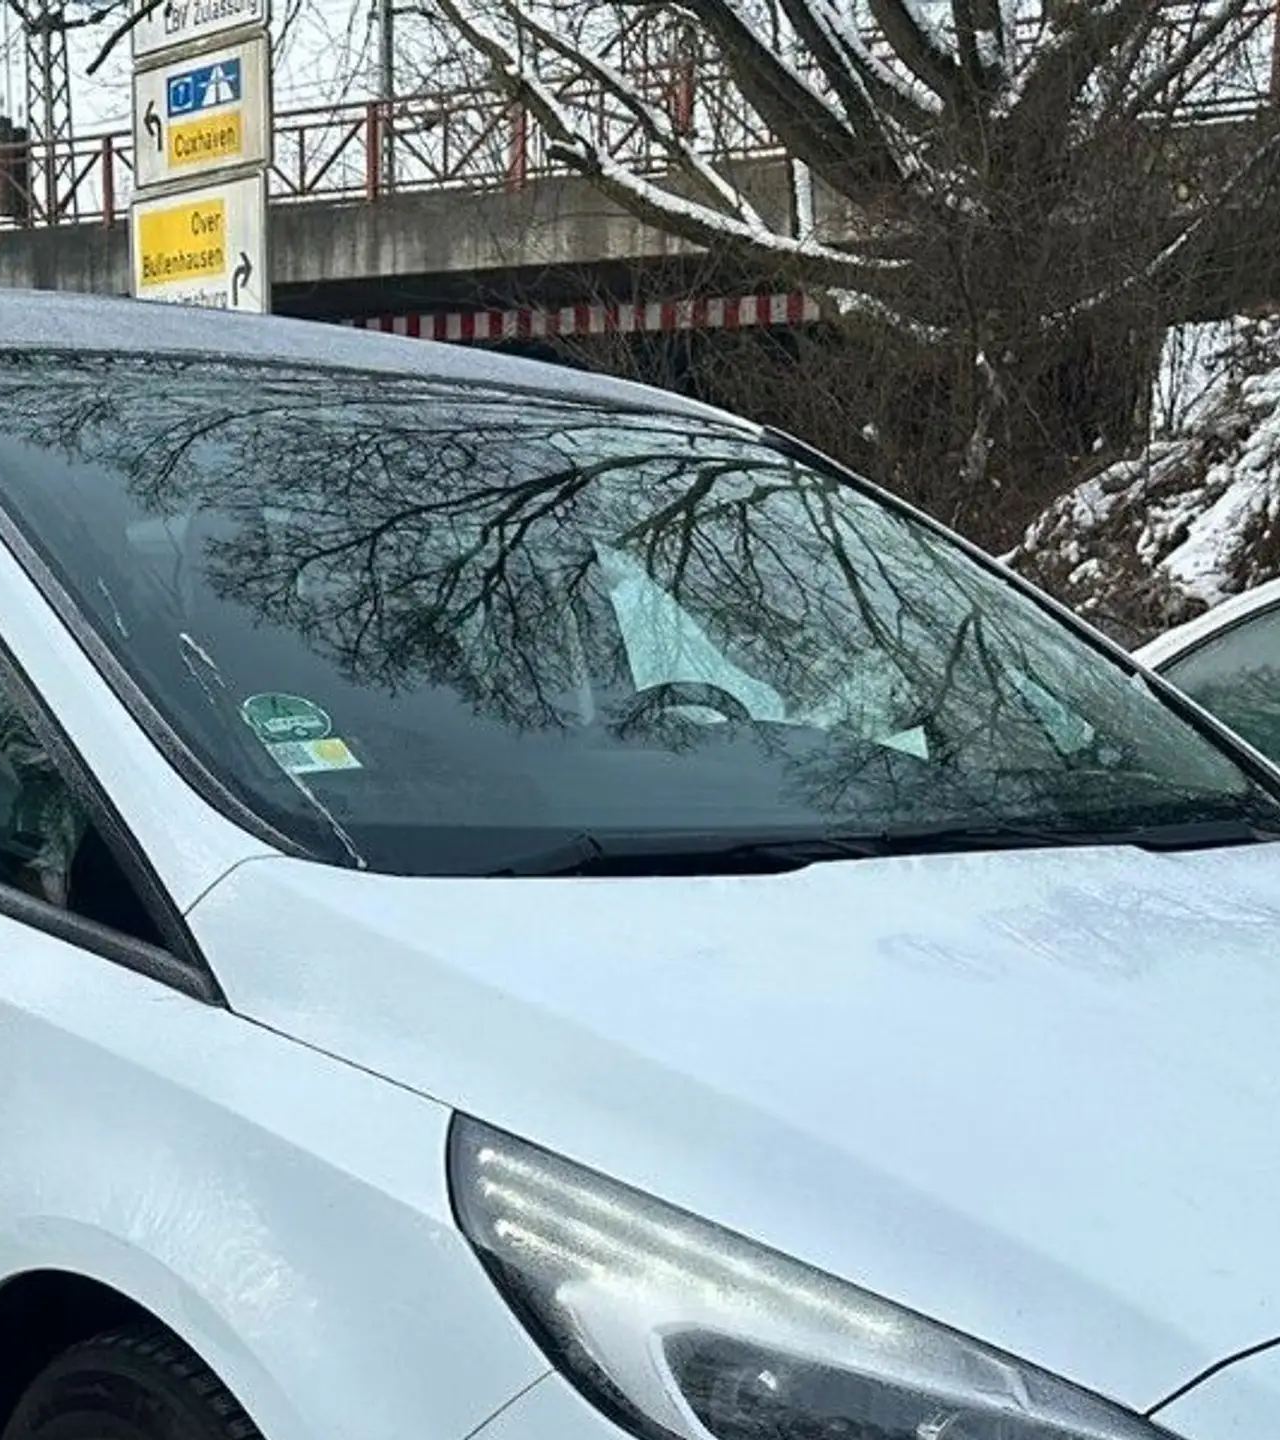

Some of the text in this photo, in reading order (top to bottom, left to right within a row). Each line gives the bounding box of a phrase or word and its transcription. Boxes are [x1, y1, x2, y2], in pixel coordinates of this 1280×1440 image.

[174, 127, 236, 157] Cuxhaven
[191, 211, 222, 235] Over
[143, 248, 224, 278] Bullenhausen
